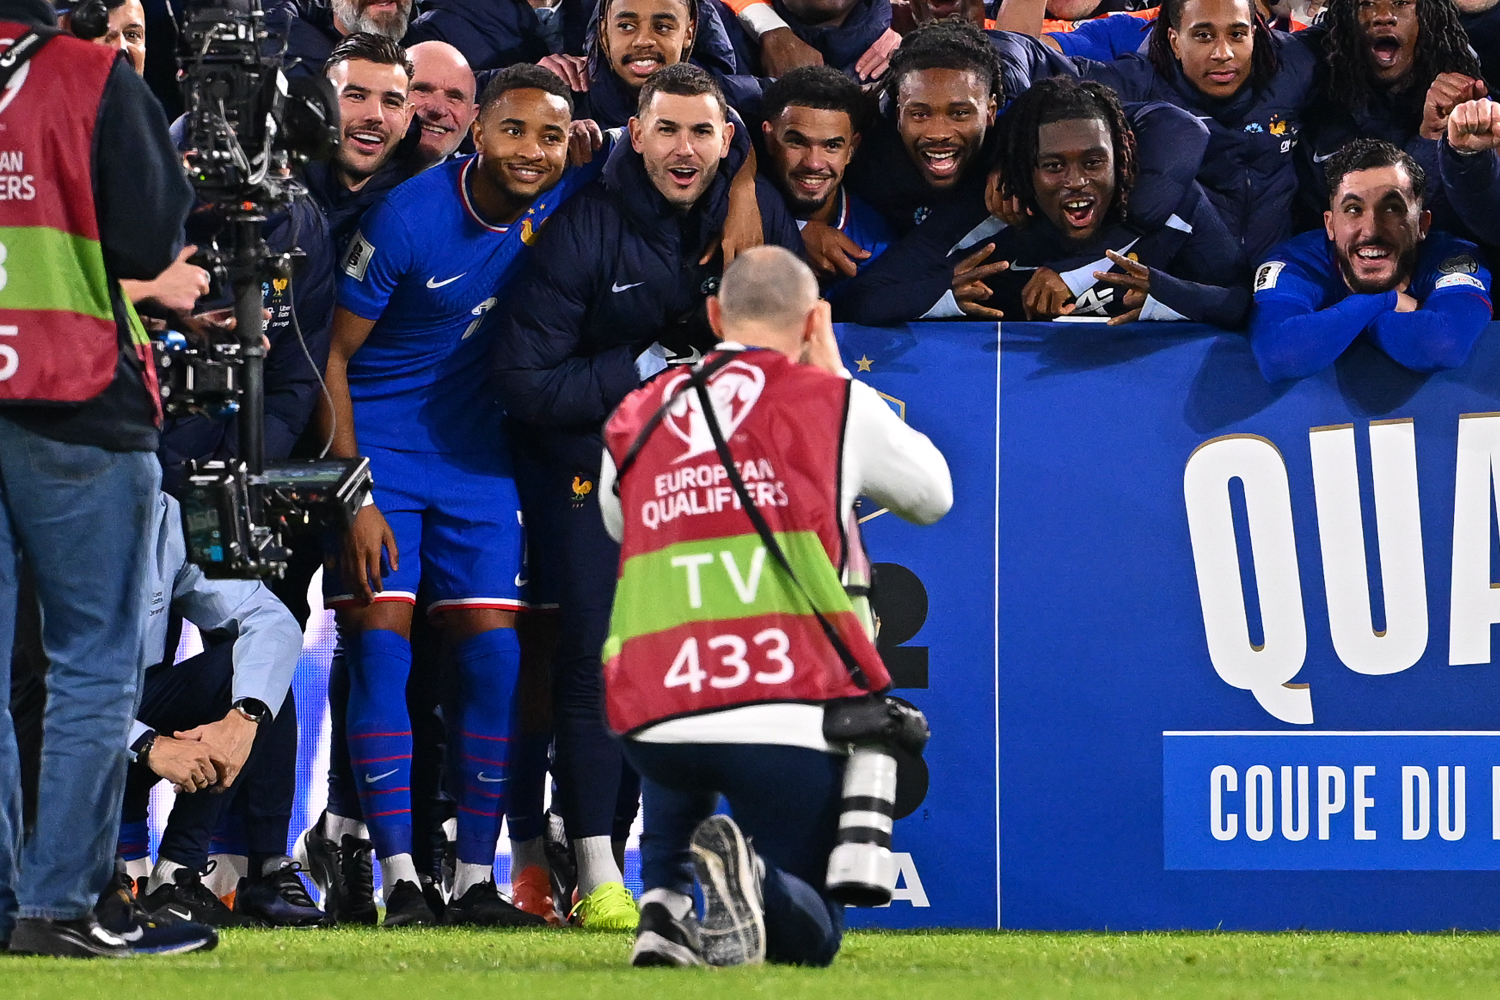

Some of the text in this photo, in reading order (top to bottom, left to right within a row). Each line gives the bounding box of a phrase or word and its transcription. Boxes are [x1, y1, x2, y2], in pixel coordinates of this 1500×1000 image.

[655, 458, 775, 497] EUROPAN
[671, 546, 767, 609] TV
[663, 628, 795, 693] 433
[1209, 764, 1377, 842] COUPE
[1401, 765, 1466, 842] DU
